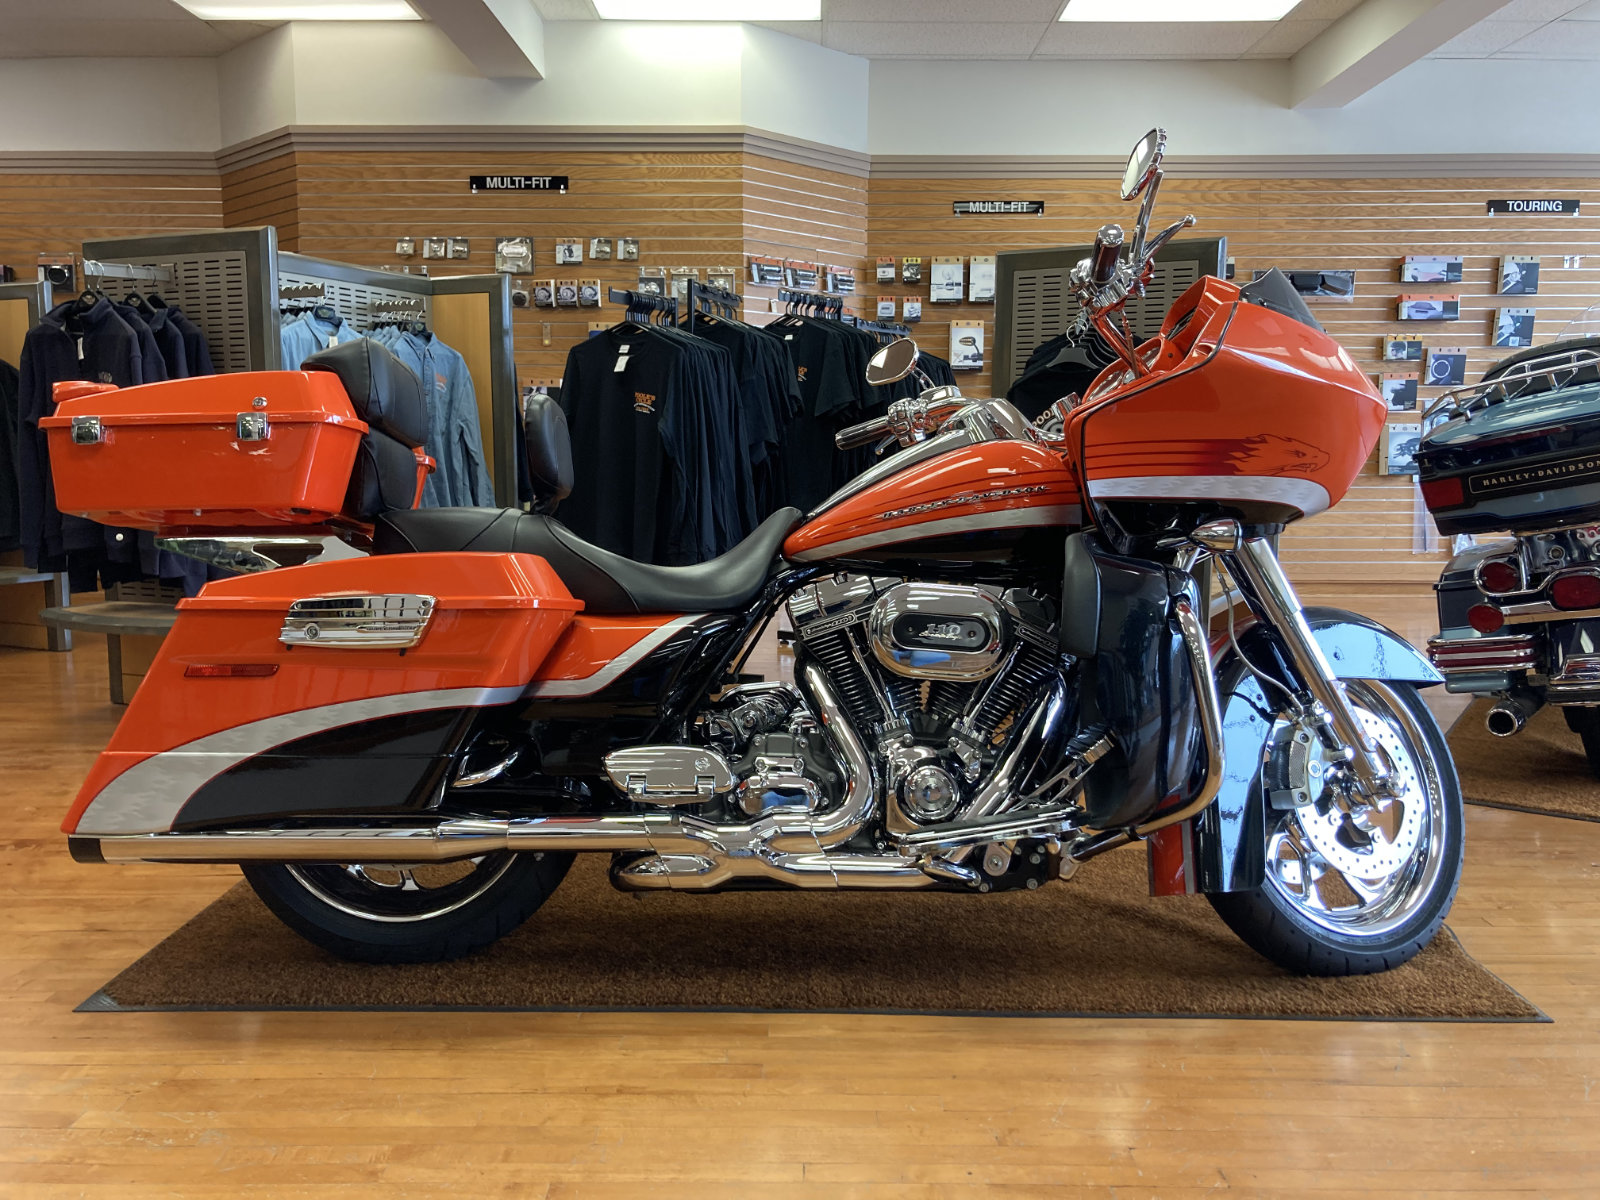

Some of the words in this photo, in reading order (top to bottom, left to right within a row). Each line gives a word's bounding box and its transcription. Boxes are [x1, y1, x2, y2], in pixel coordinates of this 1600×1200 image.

[486, 177, 552, 189] MULTI-FIT
[969, 201, 1029, 213] MULTI-FIT
[1506, 200, 1563, 212] TOURING
